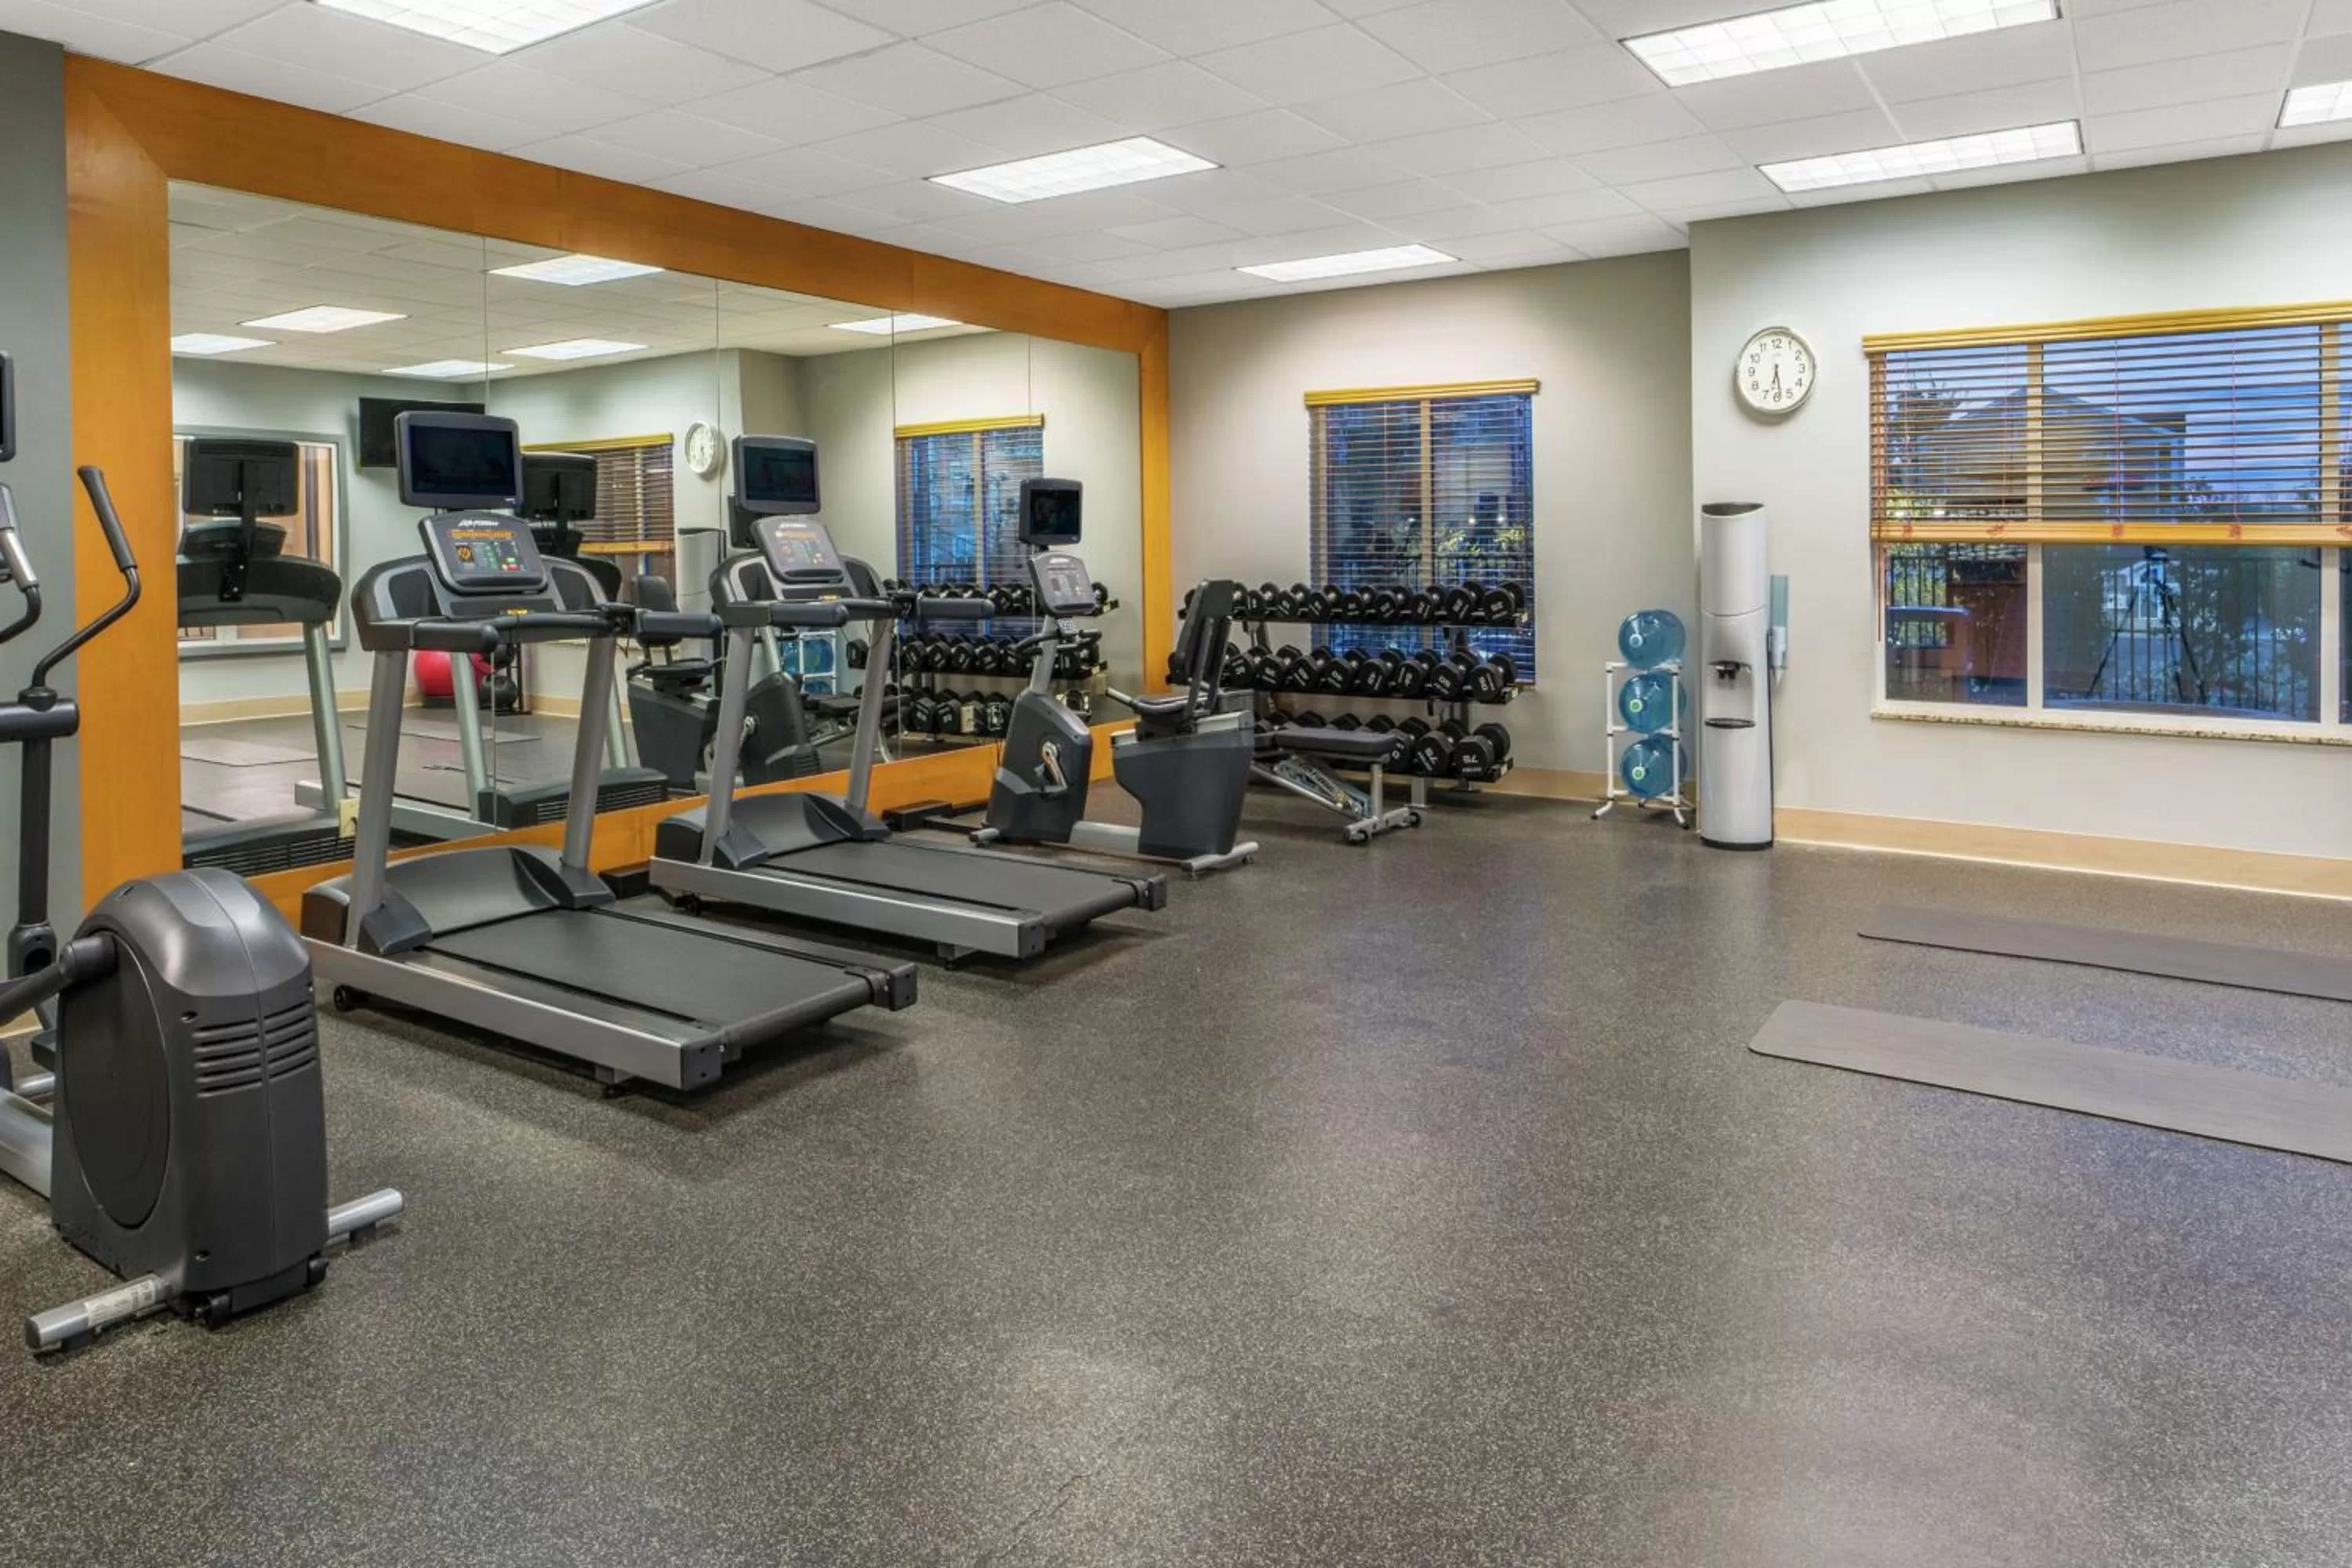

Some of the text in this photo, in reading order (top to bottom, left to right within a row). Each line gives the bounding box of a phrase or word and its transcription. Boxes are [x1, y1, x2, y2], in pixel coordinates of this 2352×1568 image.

[1759, 342, 1767, 353] 11
[1771, 338, 1782, 350] 12
[1788, 339, 1792, 351] 1
[1750, 352, 1761, 365] 10
[1795, 349, 1802, 361] 2
[1748, 366, 1756, 377] 9
[1798, 363, 1806, 374] 3
[1751, 379, 1759, 391] 8
[1795, 376, 1803, 388] 4
[1762, 389, 1770, 401] 7
[1785, 388, 1795, 399] 5
